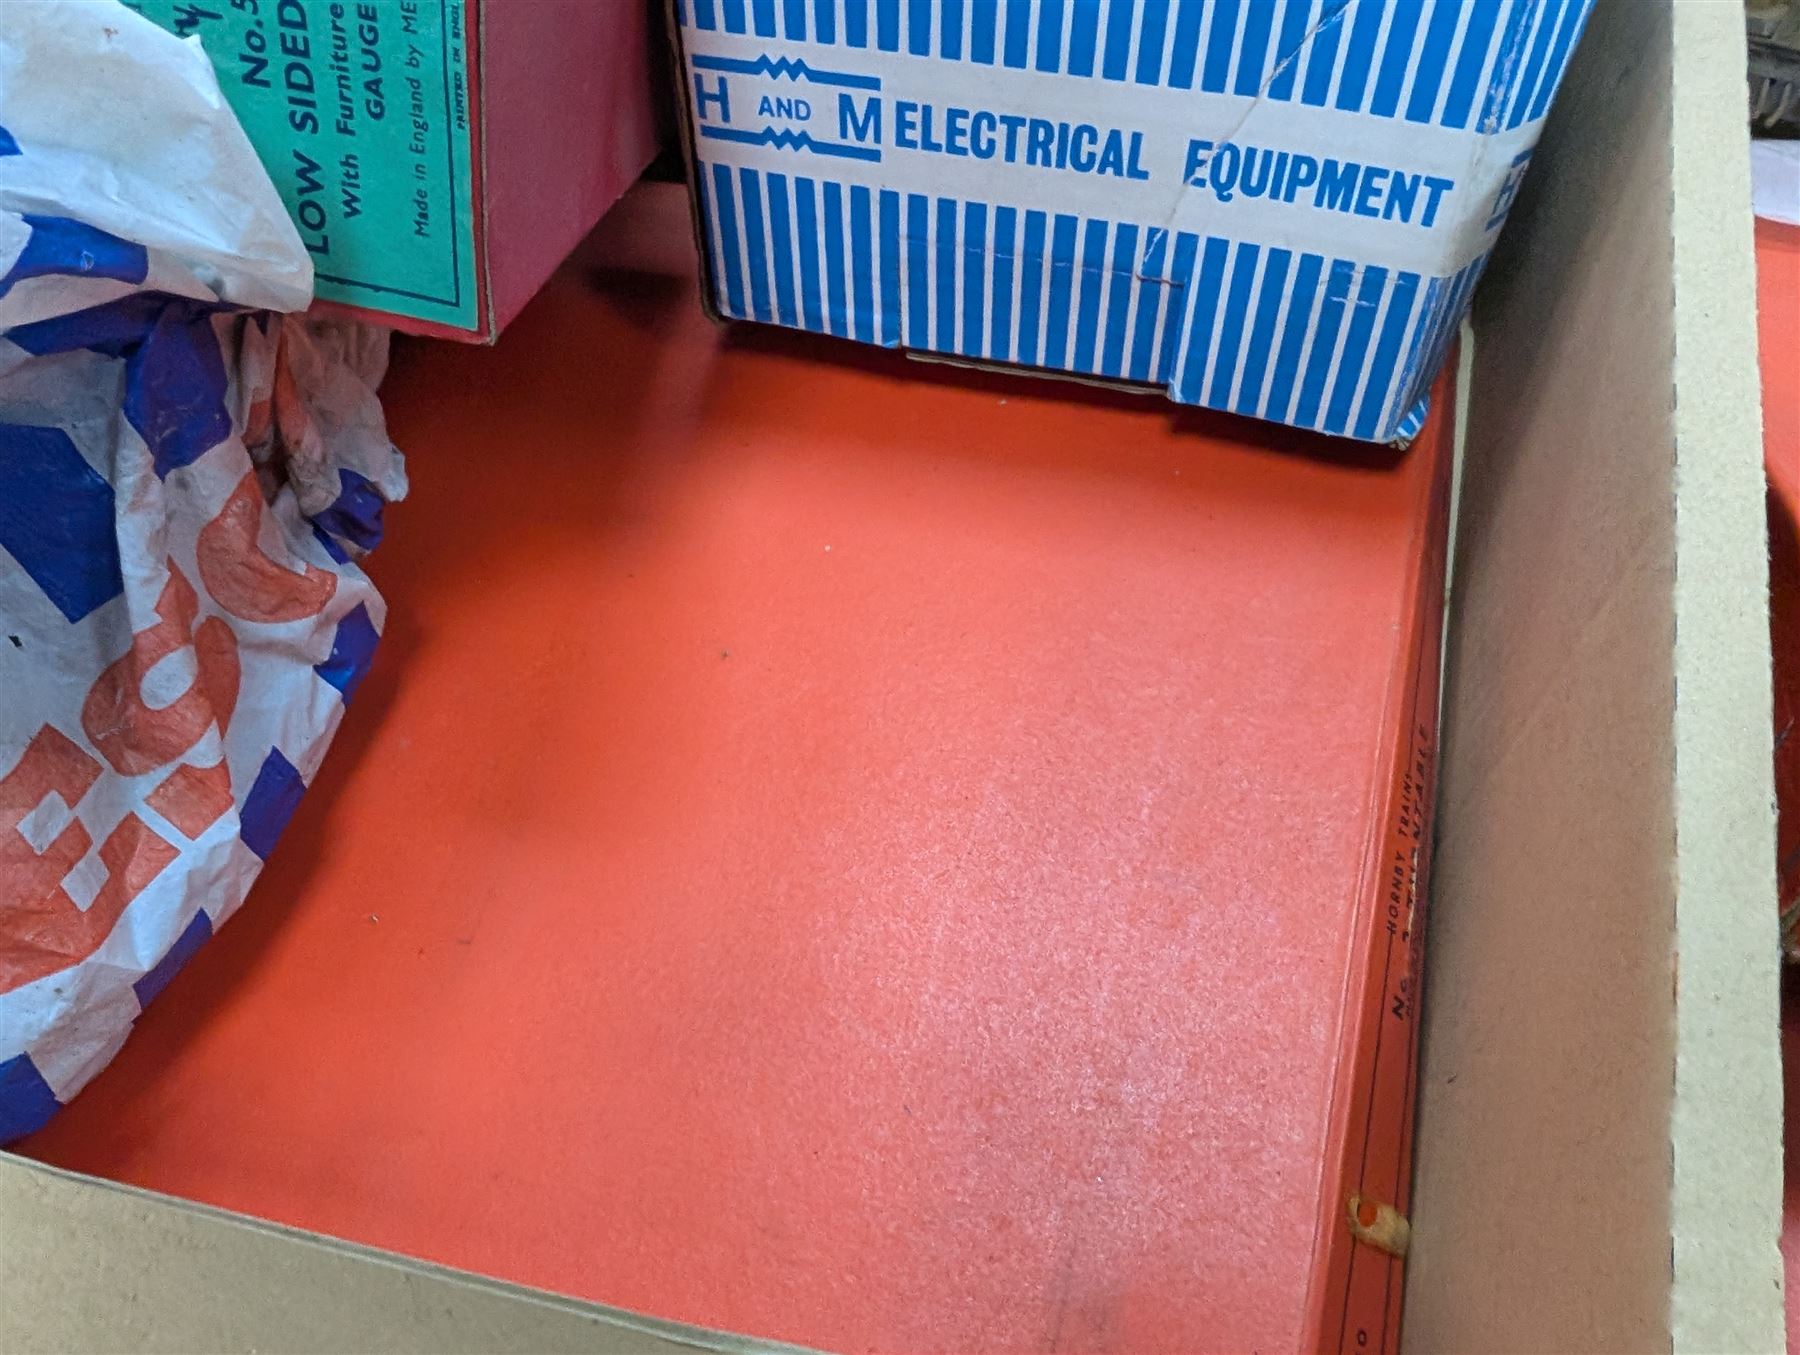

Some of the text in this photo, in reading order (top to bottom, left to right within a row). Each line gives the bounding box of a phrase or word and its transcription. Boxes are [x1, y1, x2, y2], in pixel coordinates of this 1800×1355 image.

[357, 3, 385, 120] GAUGE
[405, 45, 424, 69] by
[453, 71, 465, 131] PRINTED
[277, 0, 329, 255] LOW SIDED
[329, 3, 362, 219] With Furniture
[406, 77, 428, 155] England
[694, 73, 1455, 228] H AND M ELECTRICAL EQUIPMENT
[411, 188, 430, 238] Made
[413, 163, 426, 181] in
[1386, 772, 1412, 935] HORNBY TRAINS
